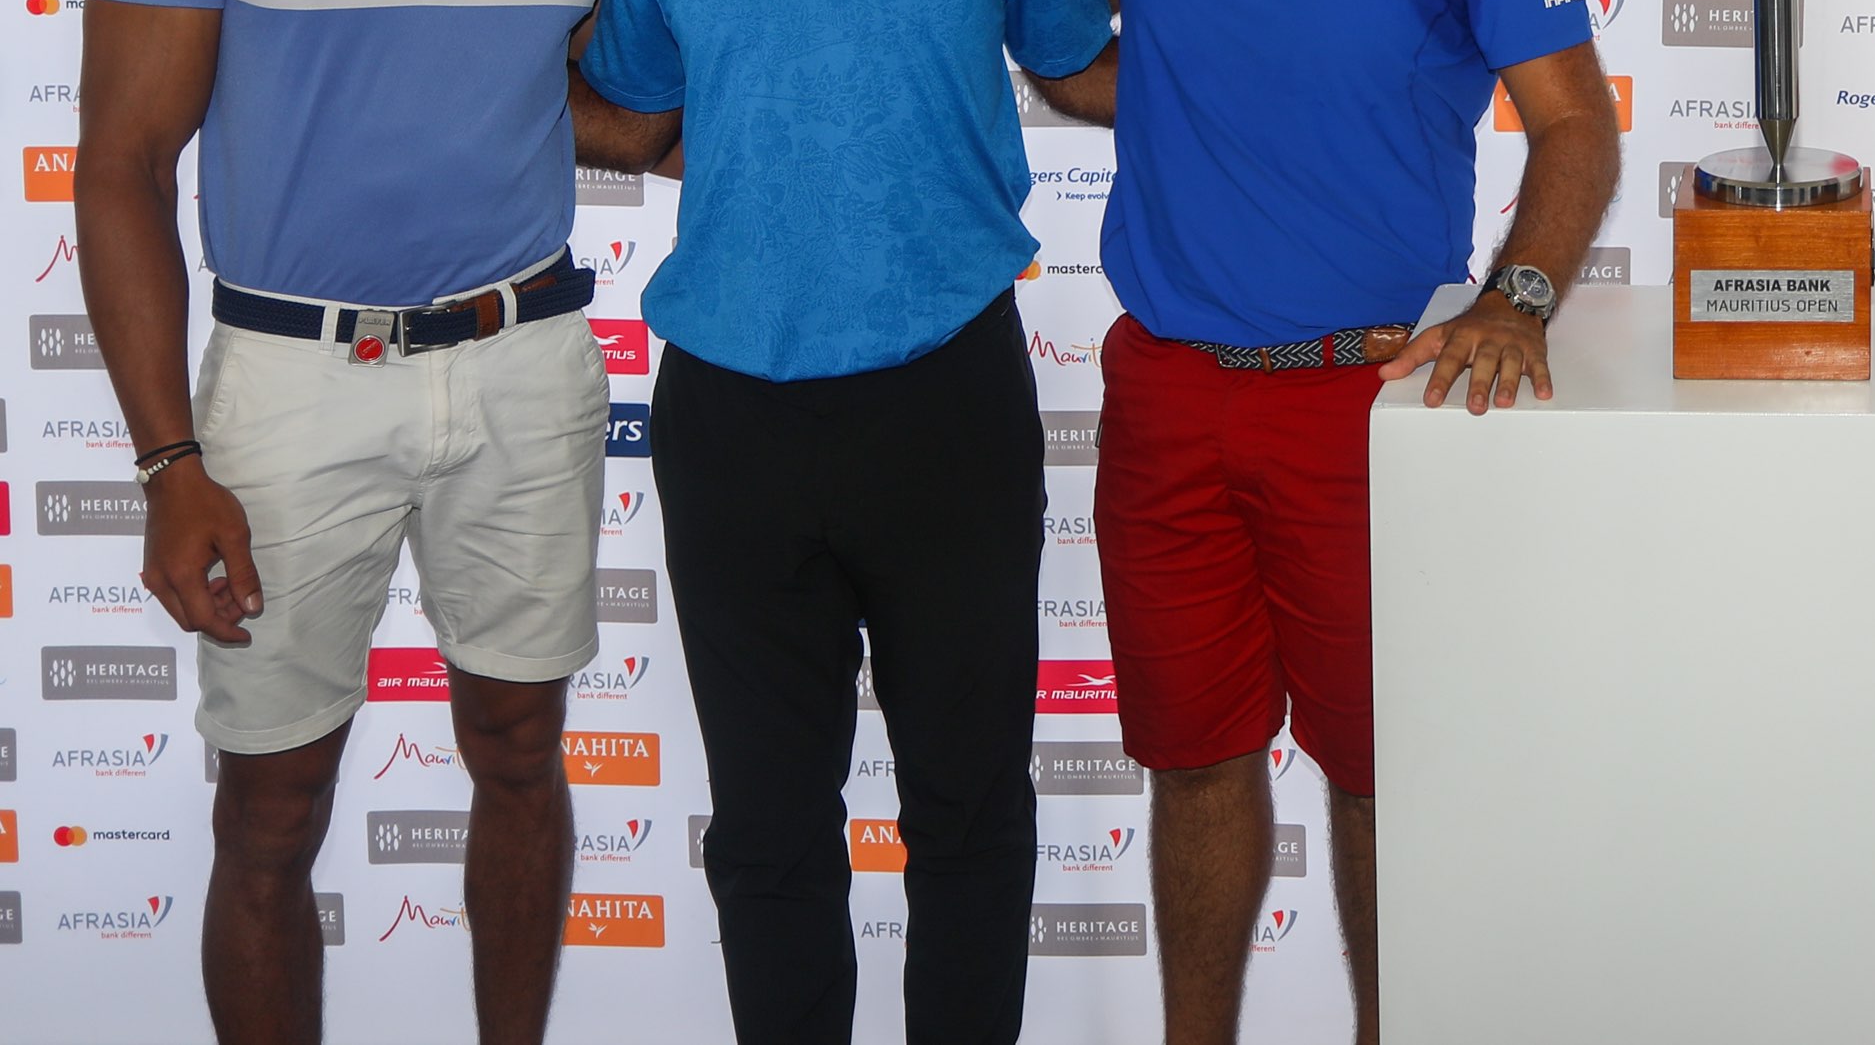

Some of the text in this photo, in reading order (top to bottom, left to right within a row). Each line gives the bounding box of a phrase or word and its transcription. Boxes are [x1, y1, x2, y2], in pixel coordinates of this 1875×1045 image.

[1713, 277, 1832, 293] AFRASIA BANK
[1707, 300, 1837, 314] MAURITIUS OPEN
[94, 830, 169, 840] mastercard
[58, 912, 151, 932] AFRASIA
[1057, 921, 1138, 932] HERITAGE
